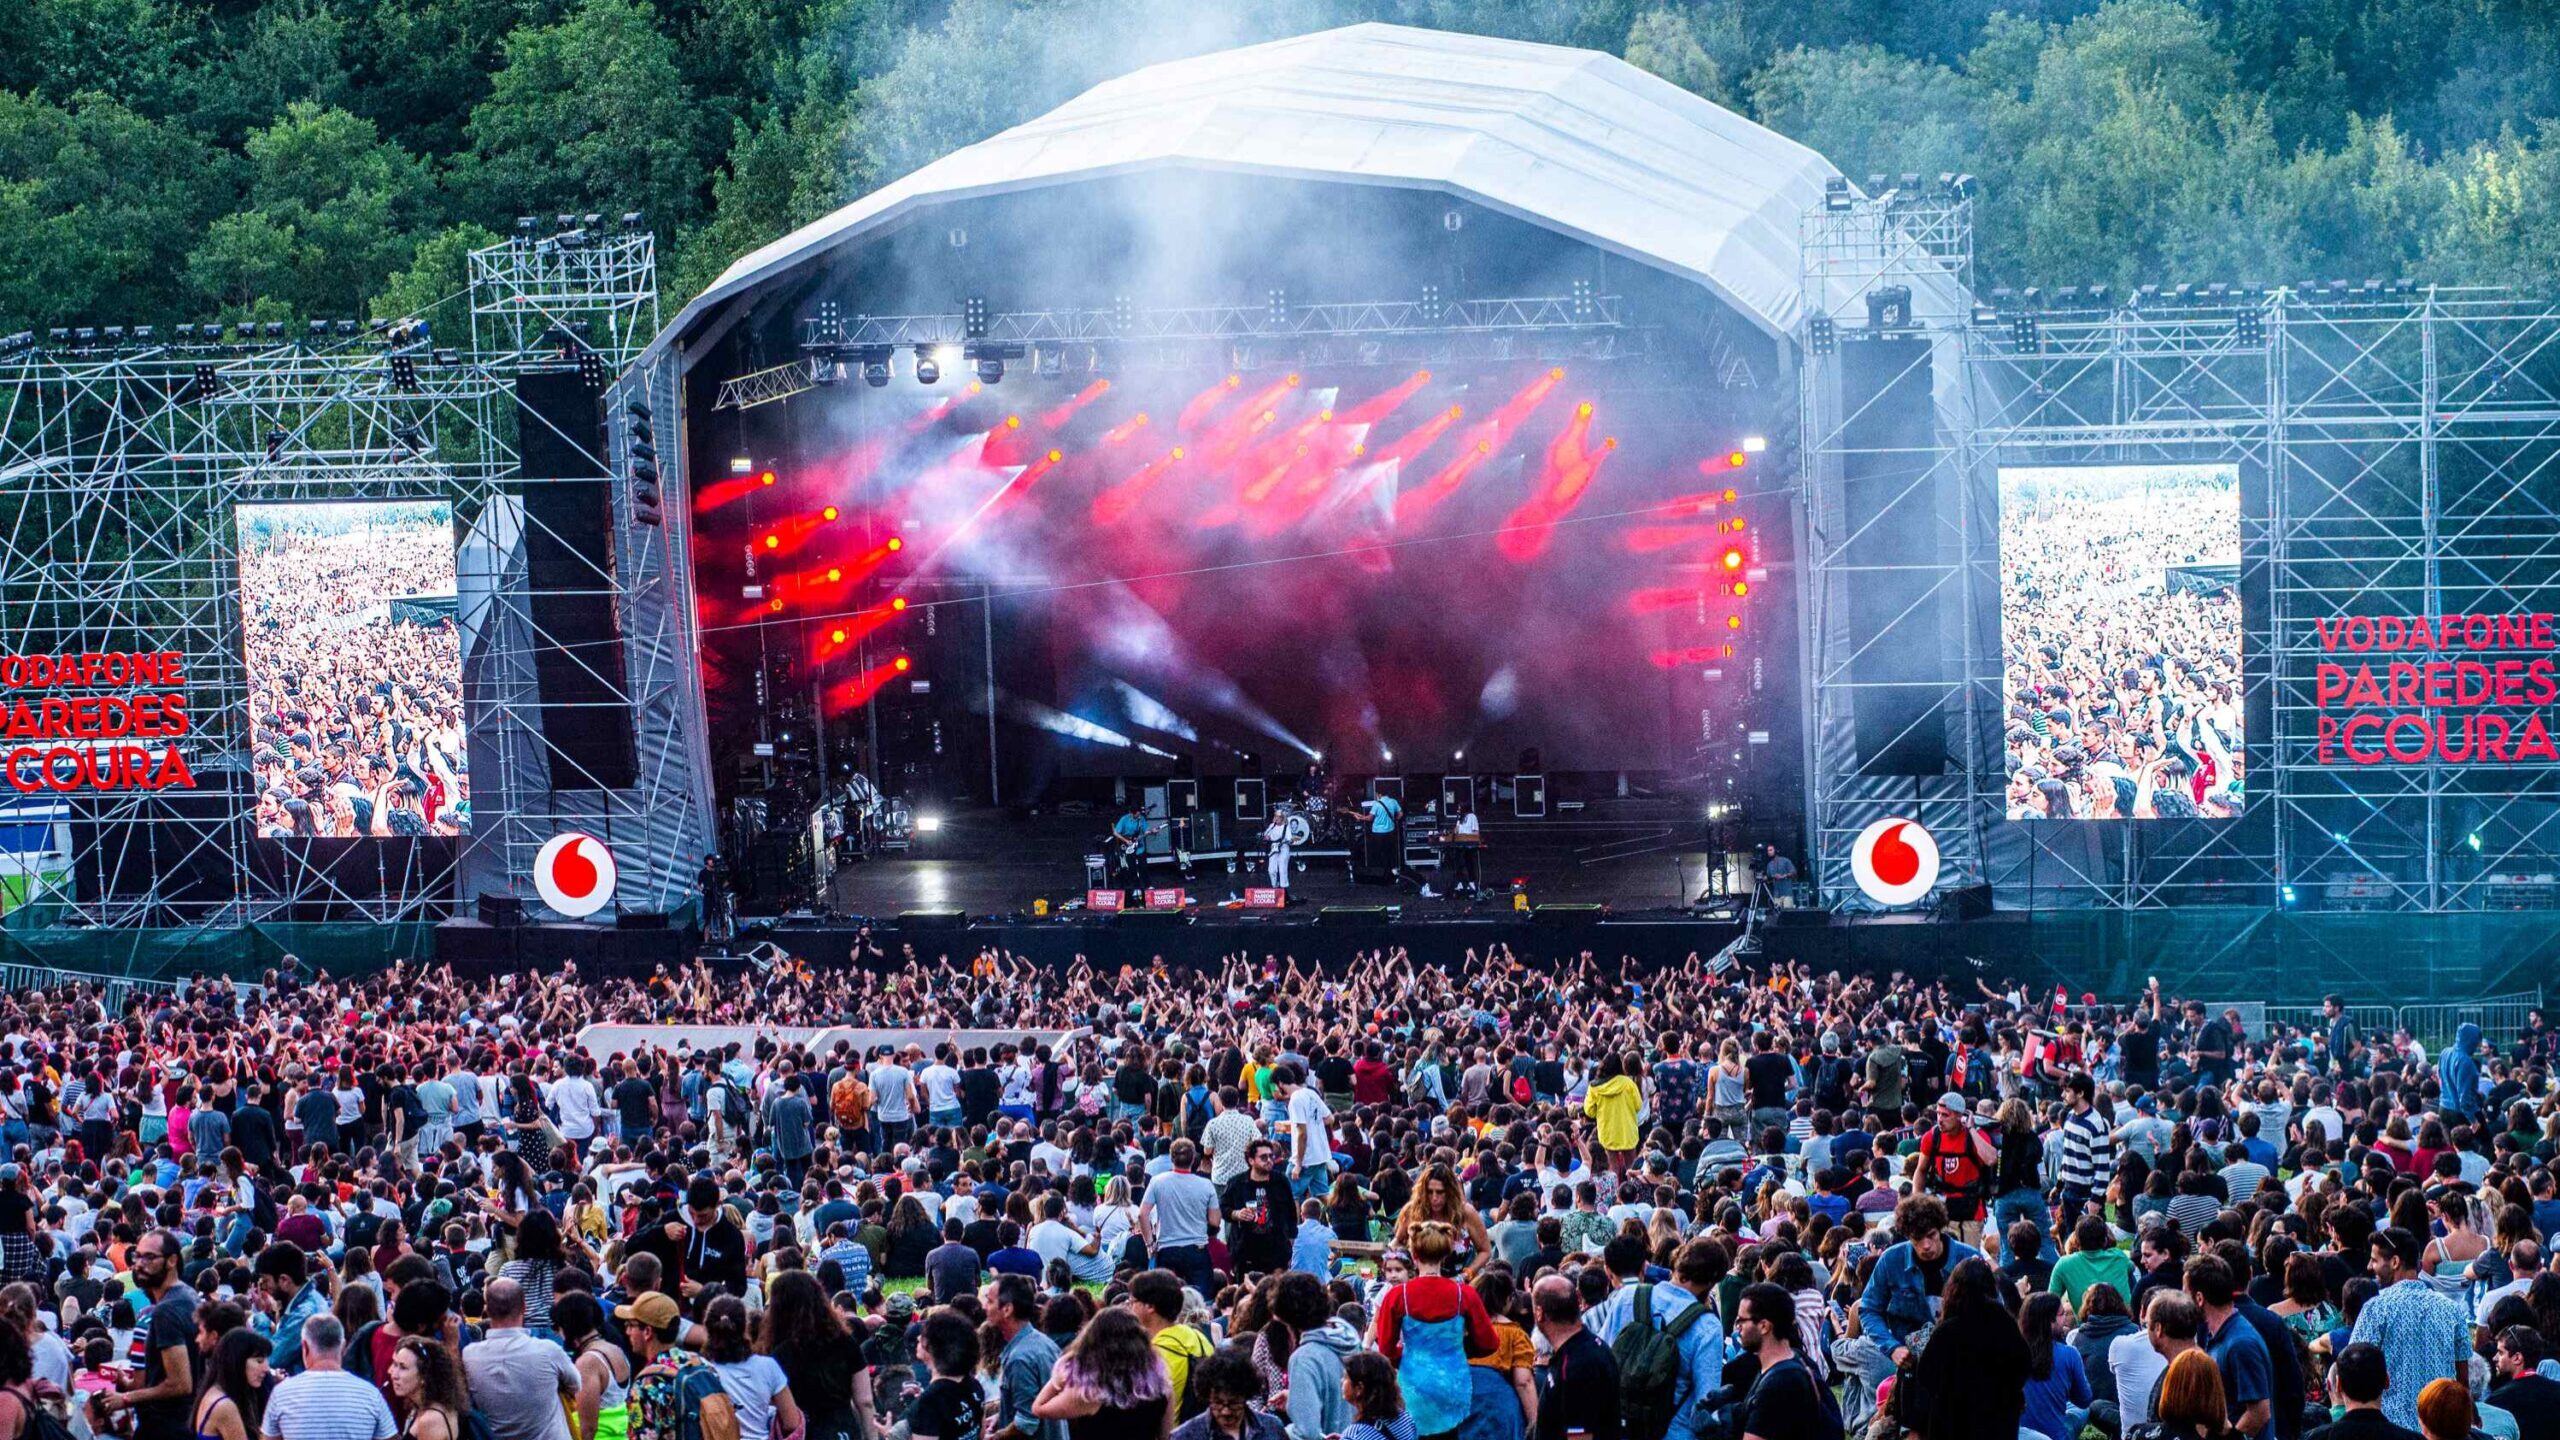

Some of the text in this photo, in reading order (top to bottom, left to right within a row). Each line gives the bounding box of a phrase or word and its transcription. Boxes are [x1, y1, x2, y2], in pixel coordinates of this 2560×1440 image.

[2315, 613, 2556, 652] VODAFONE
[0, 651, 186, 688] ODAFONE
[2316, 659, 2557, 708] PAREDES
[0, 693, 190, 740] AREDES
[2317, 712, 2560, 764] DE COURA
[6, 741, 197, 793] COURA
